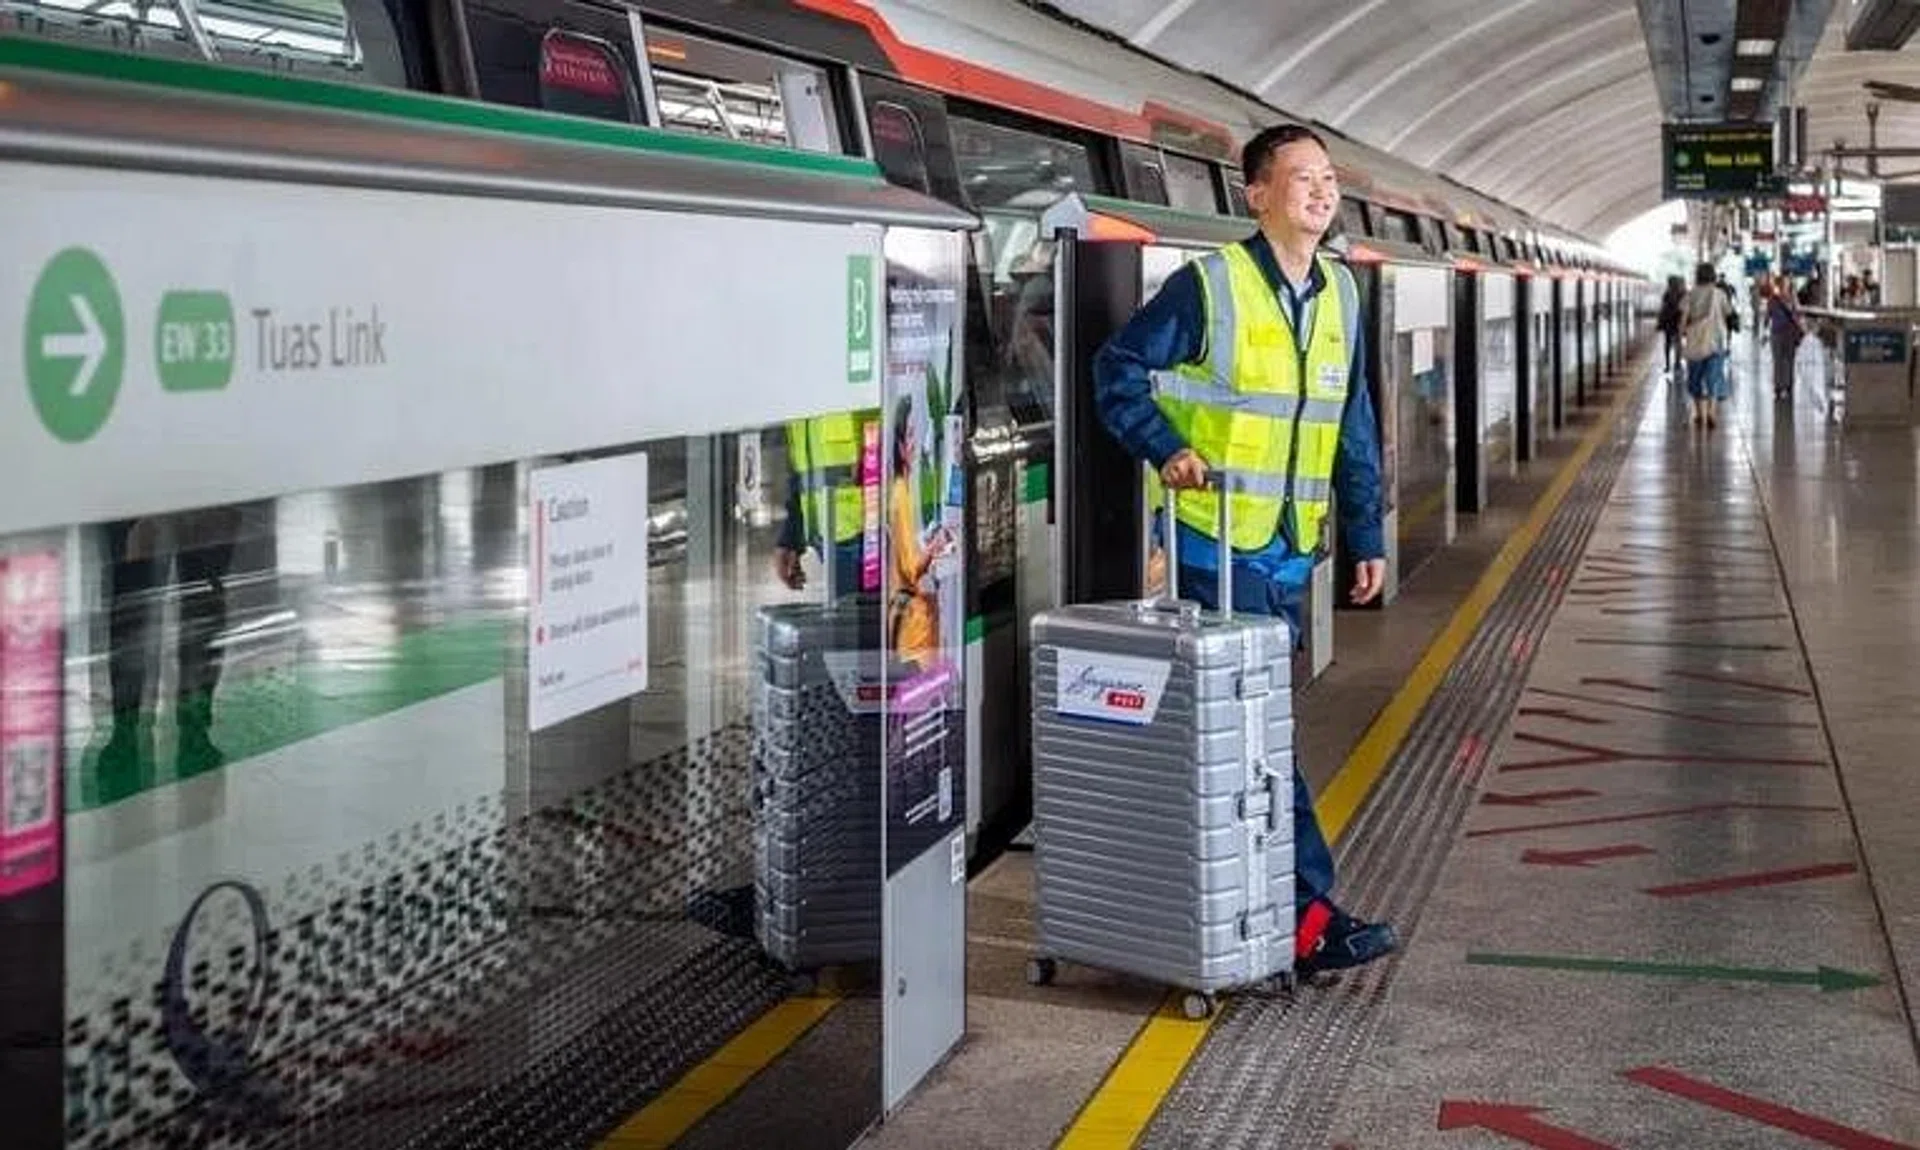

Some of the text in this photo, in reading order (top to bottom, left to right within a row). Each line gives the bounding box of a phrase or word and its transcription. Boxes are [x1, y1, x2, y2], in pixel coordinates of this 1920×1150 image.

[162, 321, 230, 362] EW 33
[251, 301, 387, 370] Tuas Link
